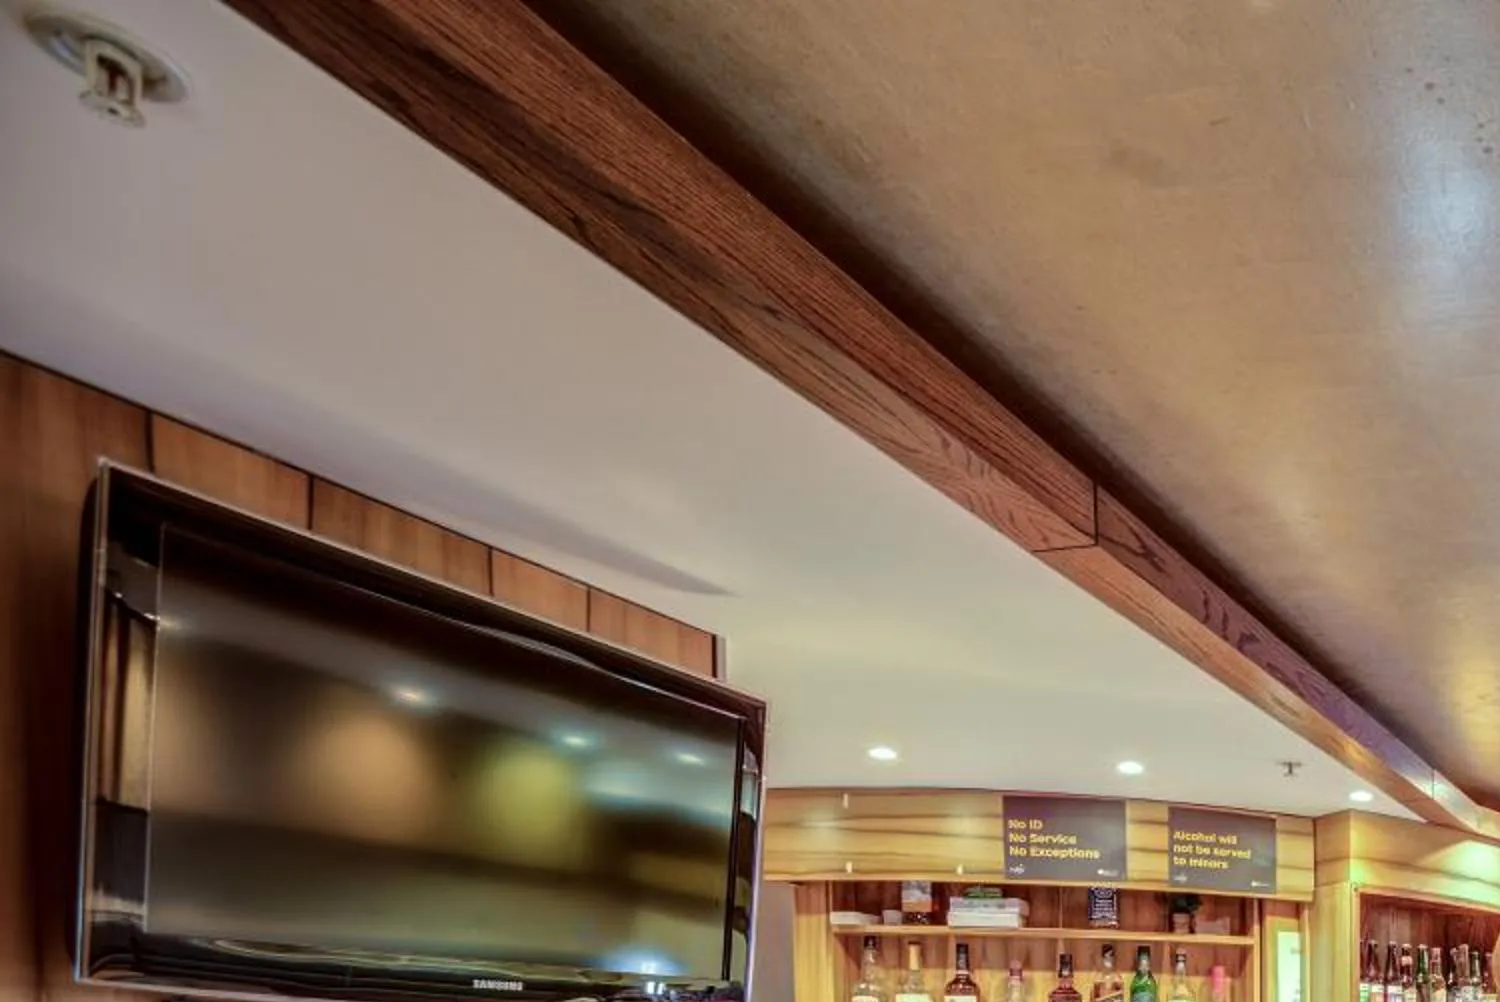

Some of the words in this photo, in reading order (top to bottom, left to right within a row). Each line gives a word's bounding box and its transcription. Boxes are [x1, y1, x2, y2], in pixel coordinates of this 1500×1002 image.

[1007, 818, 1027, 830] No
[1028, 818, 1044, 830] ID
[1008, 832, 1027, 844] No
[1028, 833, 1078, 846] Service
[1173, 831, 1217, 843] Alcohol
[1217, 834, 1238, 845] will
[1008, 845, 1028, 857] No
[1028, 846, 1101, 861] Exceptions
[1173, 844, 1194, 854] not
[1195, 845, 1212, 855] be
[1213, 847, 1252, 860] served
[1173, 856, 1188, 866] to
[1189, 858, 1230, 869] minors
[472, 979, 524, 991] SAMSUNG
